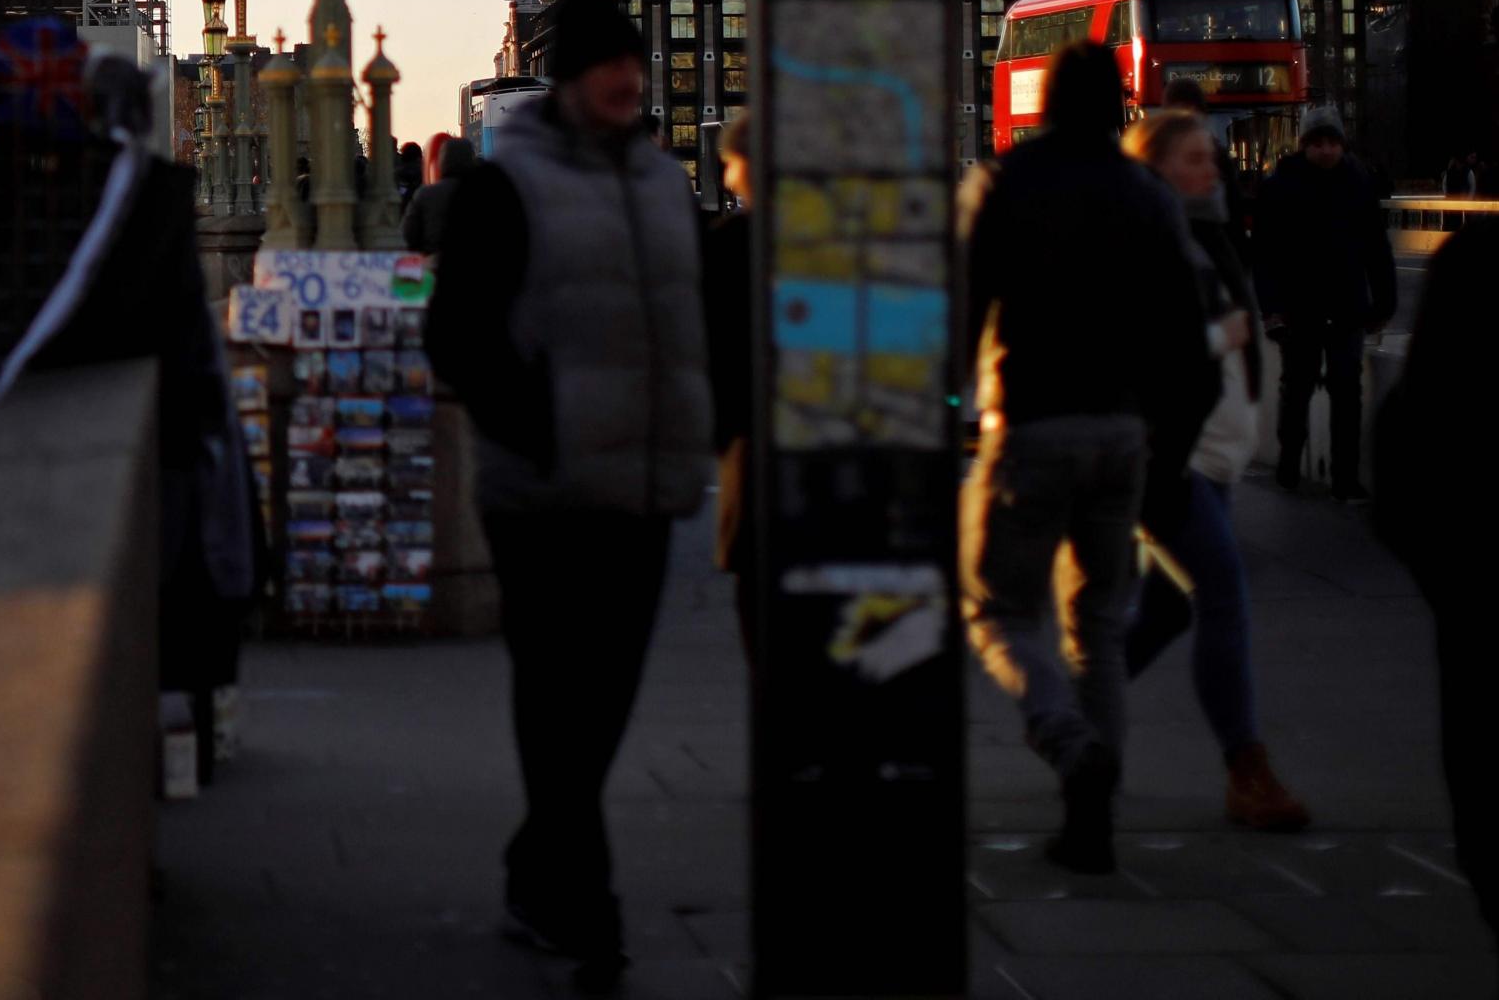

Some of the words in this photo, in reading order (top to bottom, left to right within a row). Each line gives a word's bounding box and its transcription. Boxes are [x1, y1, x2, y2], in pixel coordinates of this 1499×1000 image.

[1209, 71, 1241, 84] Library
[1258, 66, 1277, 87] 12
[240, 301, 279, 334] £4
